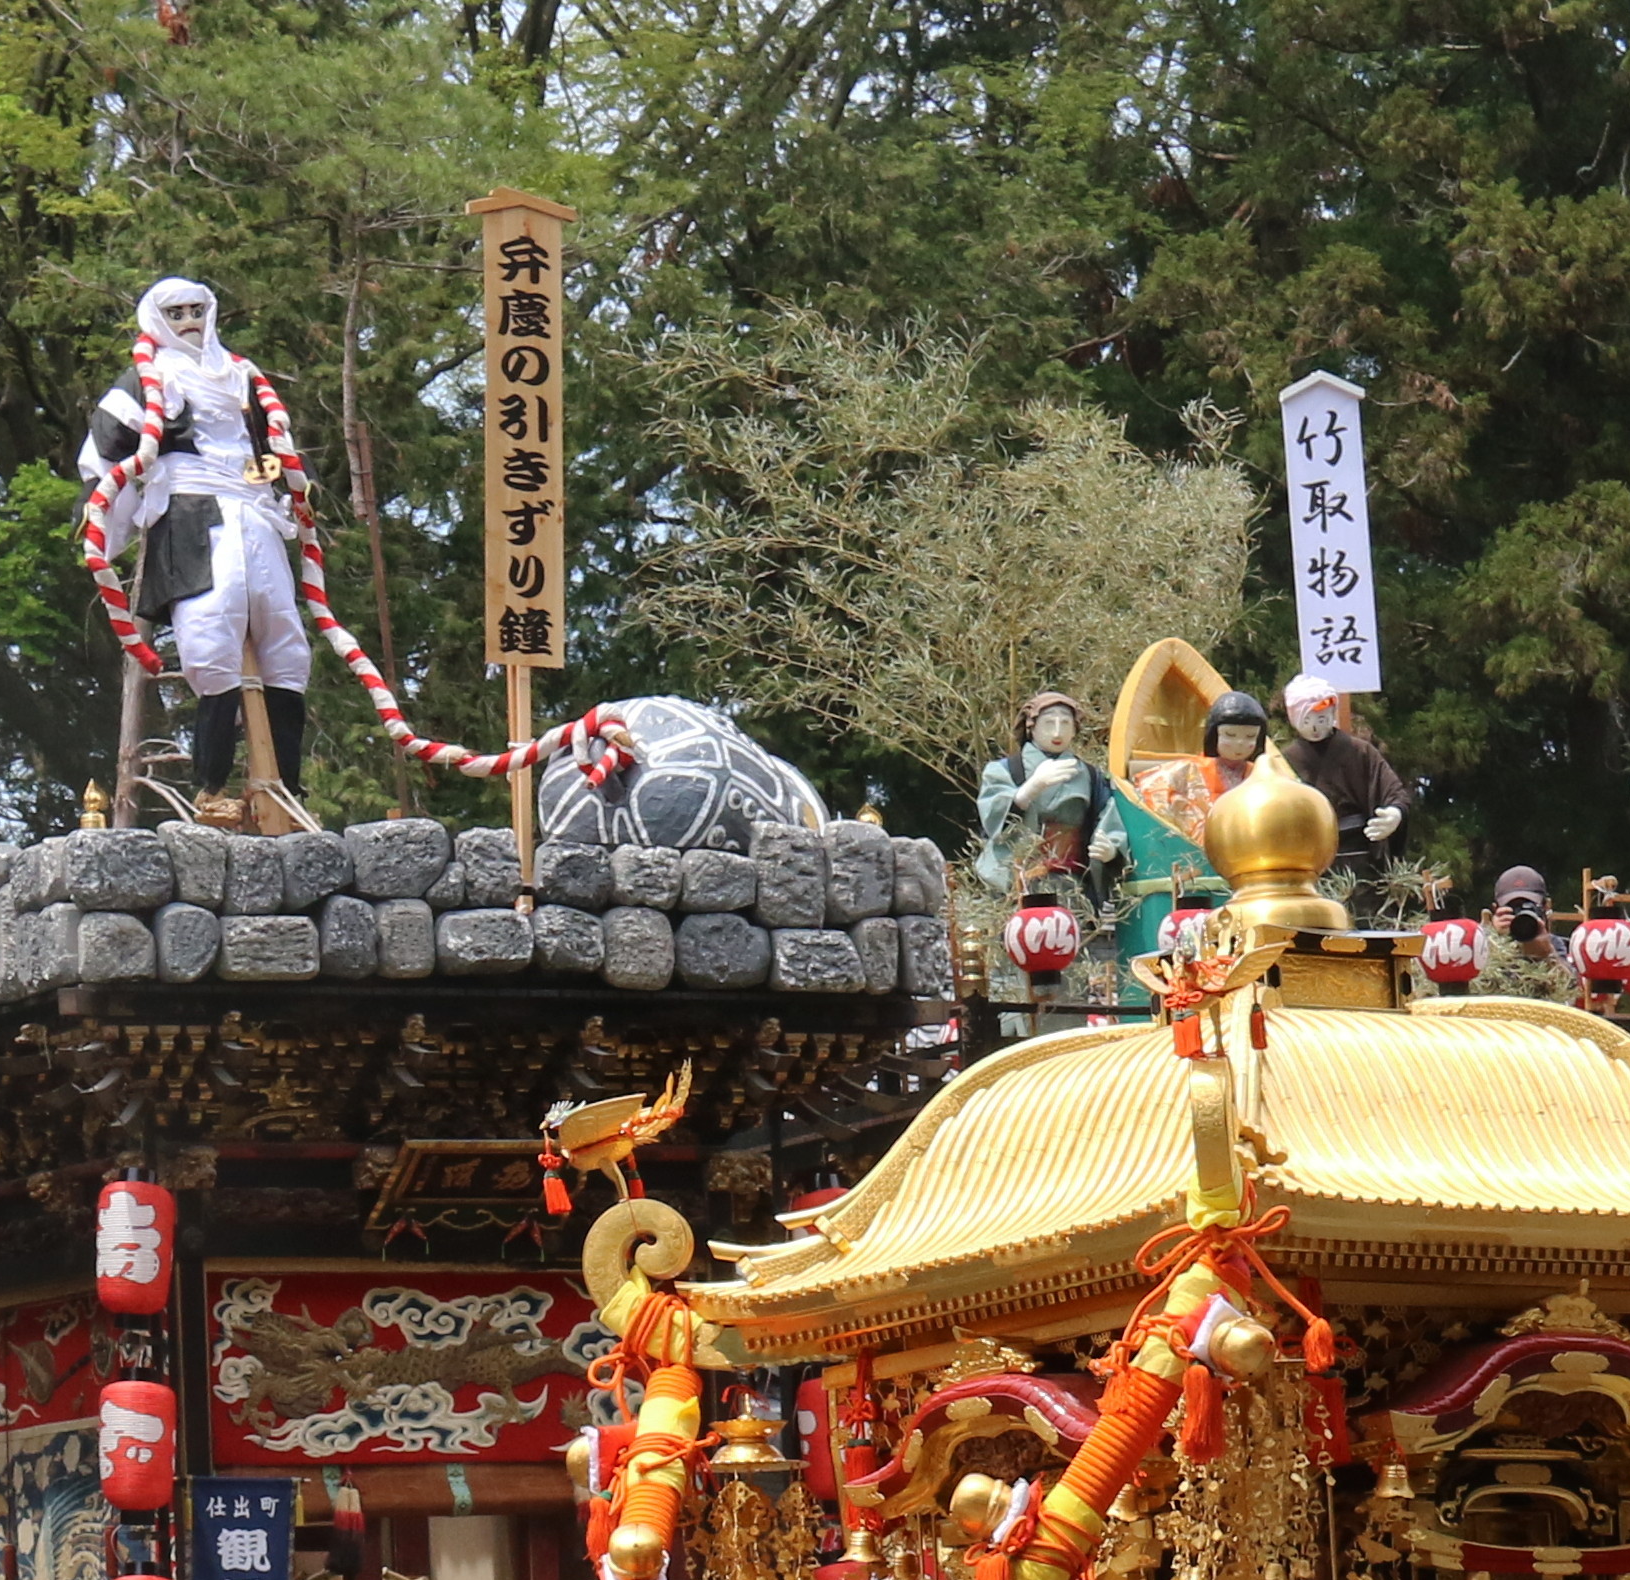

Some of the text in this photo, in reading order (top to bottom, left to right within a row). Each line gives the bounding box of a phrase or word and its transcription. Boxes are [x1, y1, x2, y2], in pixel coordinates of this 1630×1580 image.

[498, 237, 555, 655] 弁慶の引きずり鐘
[1296, 409, 1368, 665] 竹取物語
[206, 1496, 279, 1518] 仕出町
